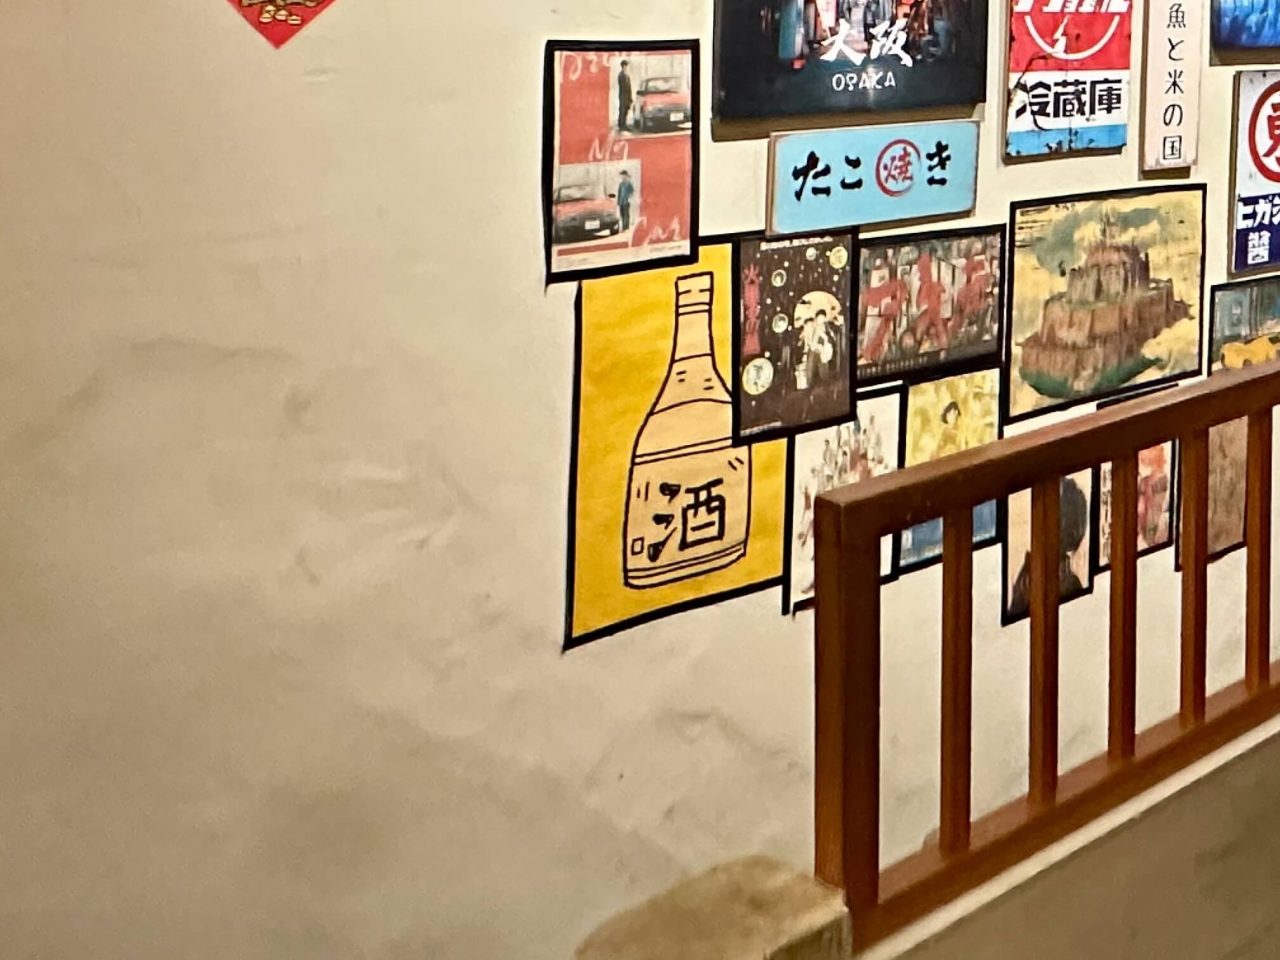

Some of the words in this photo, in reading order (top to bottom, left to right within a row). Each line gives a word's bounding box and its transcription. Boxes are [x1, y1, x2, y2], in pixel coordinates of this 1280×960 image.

[820, 19, 913, 68] 大阪
[831, 70, 896, 92] OSAKA
[1015, 77, 1123, 120] 冷蔵庫
[1162, 3, 1187, 161] 魚と米の国
[792, 140, 952, 202] たこ焼き
[647, 478, 727, 563] 酒
